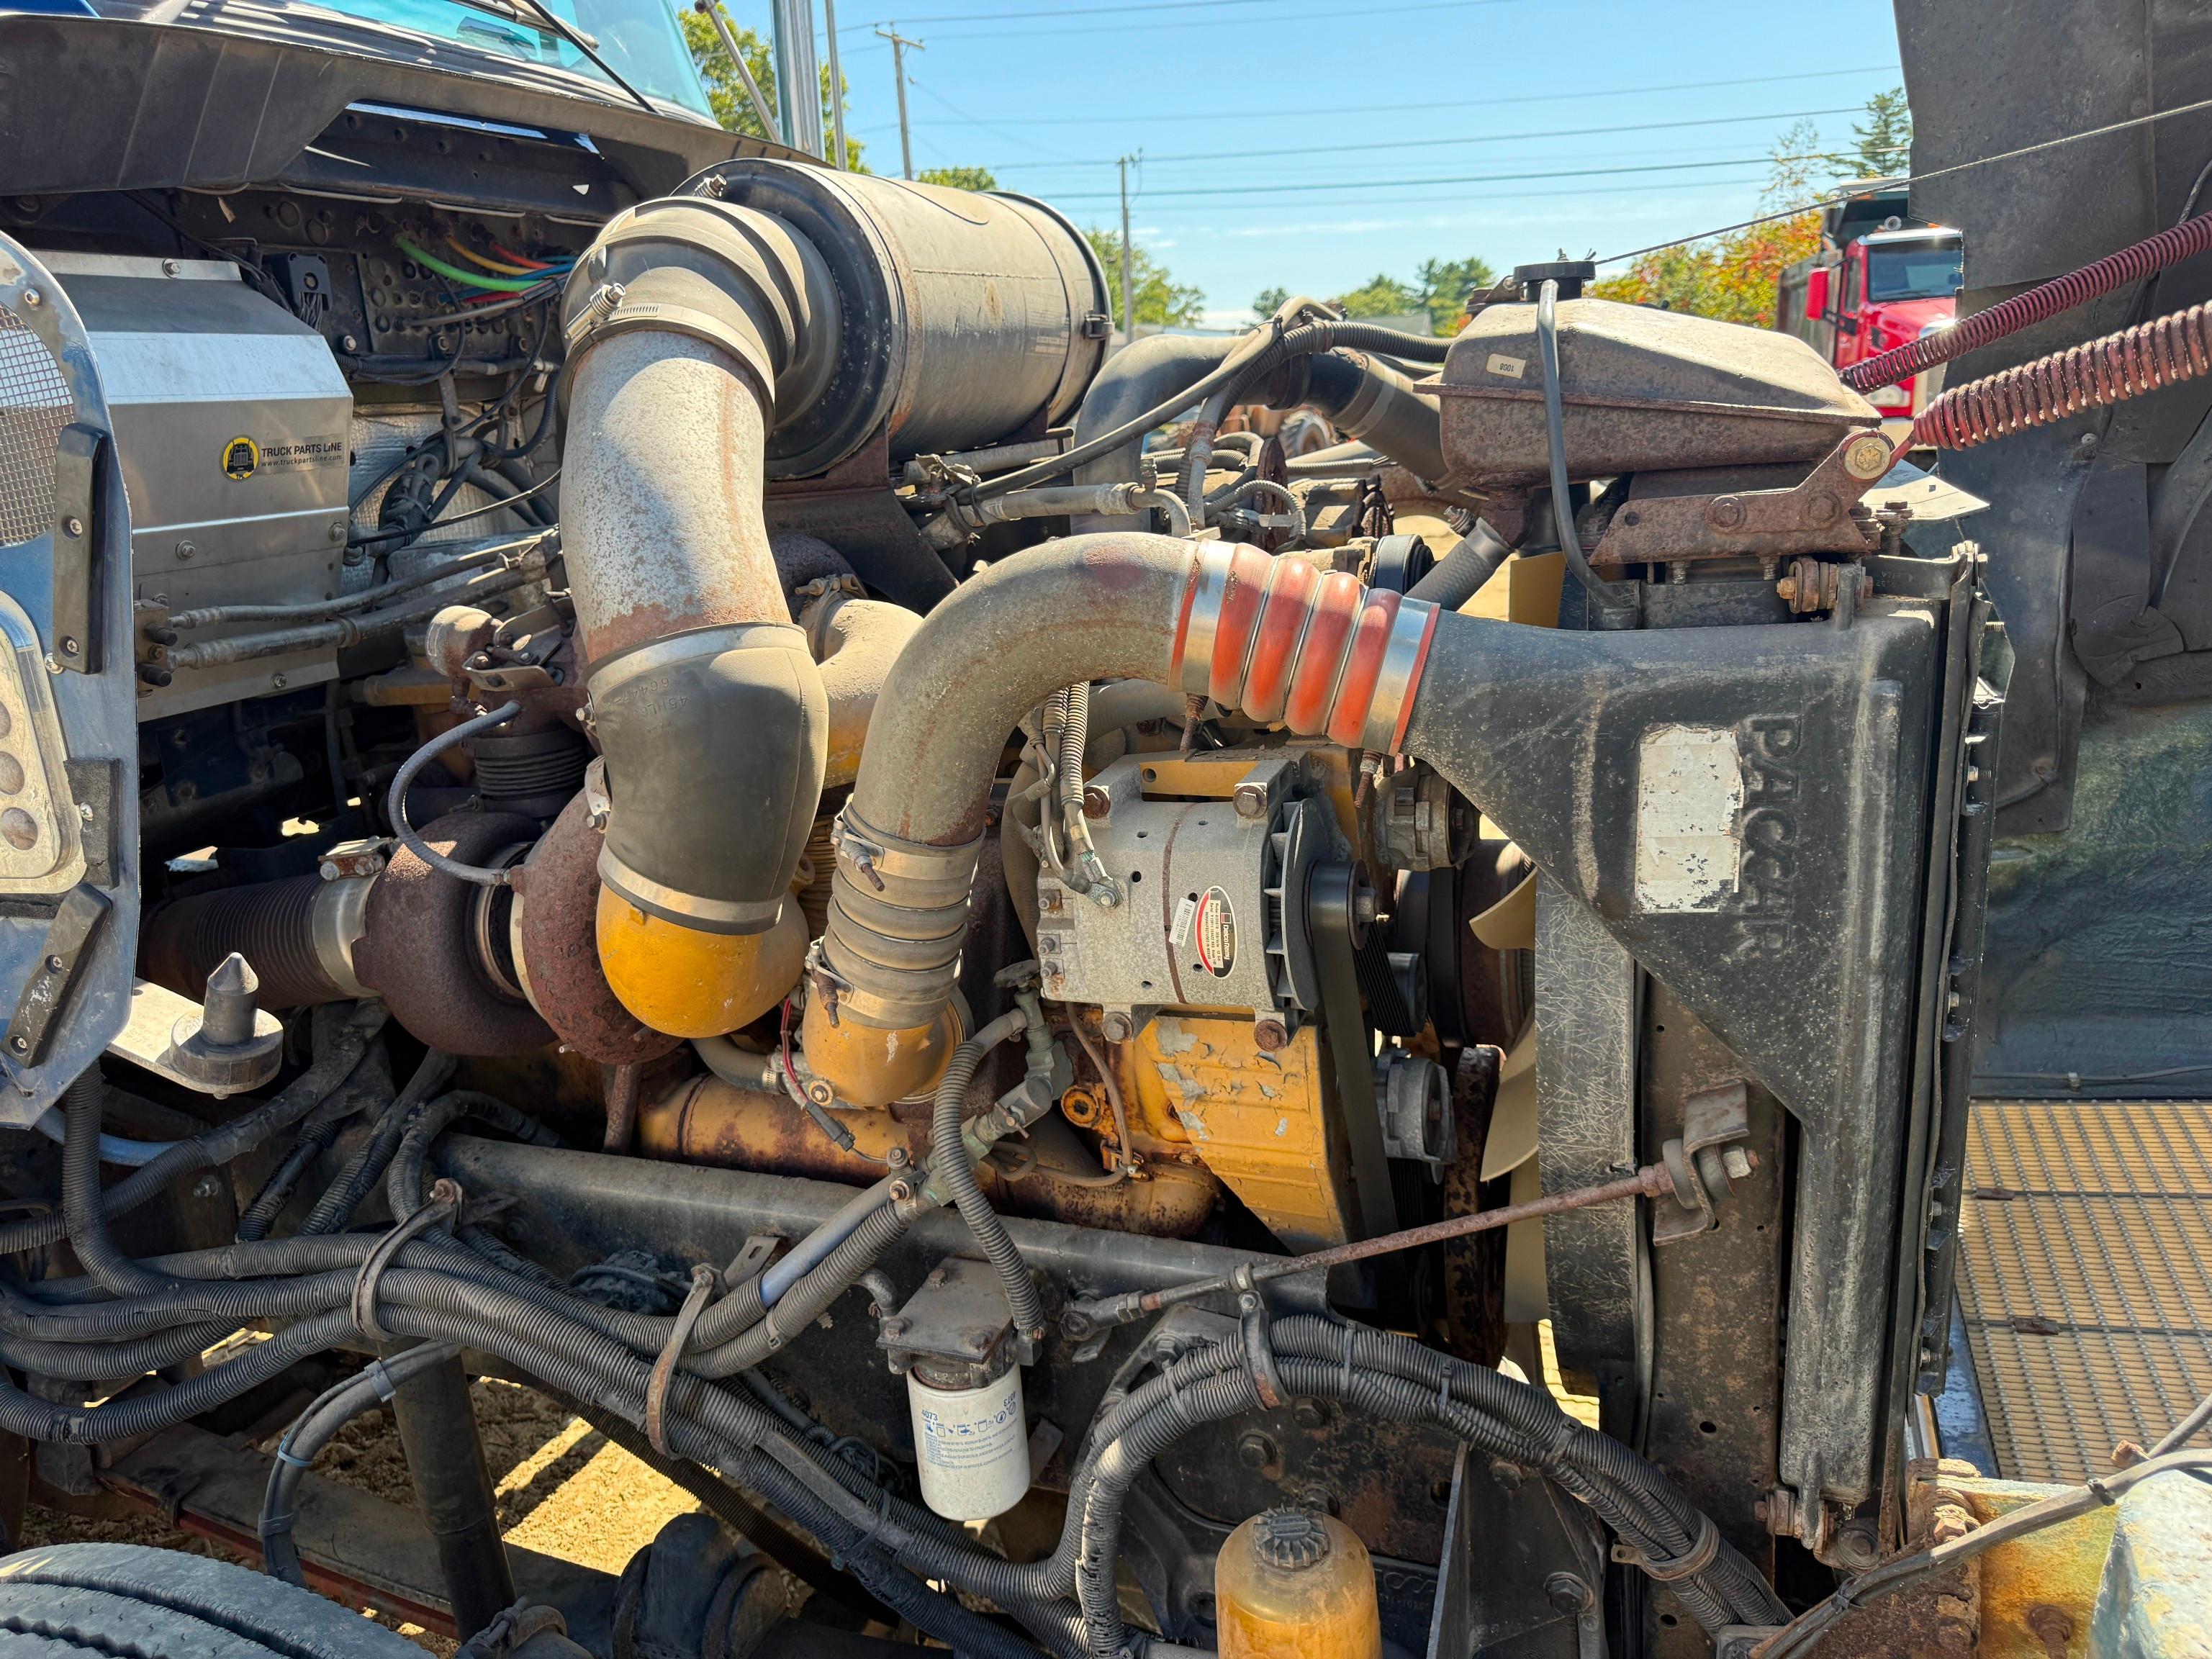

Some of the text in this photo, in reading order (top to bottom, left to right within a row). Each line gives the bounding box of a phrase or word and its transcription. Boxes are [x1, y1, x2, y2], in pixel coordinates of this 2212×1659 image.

[261, 446, 292, 458] TRUCK
[294, 443, 322, 455] PARTS
[261, 454, 342, 467] www.truckpartsline.com
[1731, 714, 1802, 957] PACCAR
[921, 1409, 938, 1421] 4073
